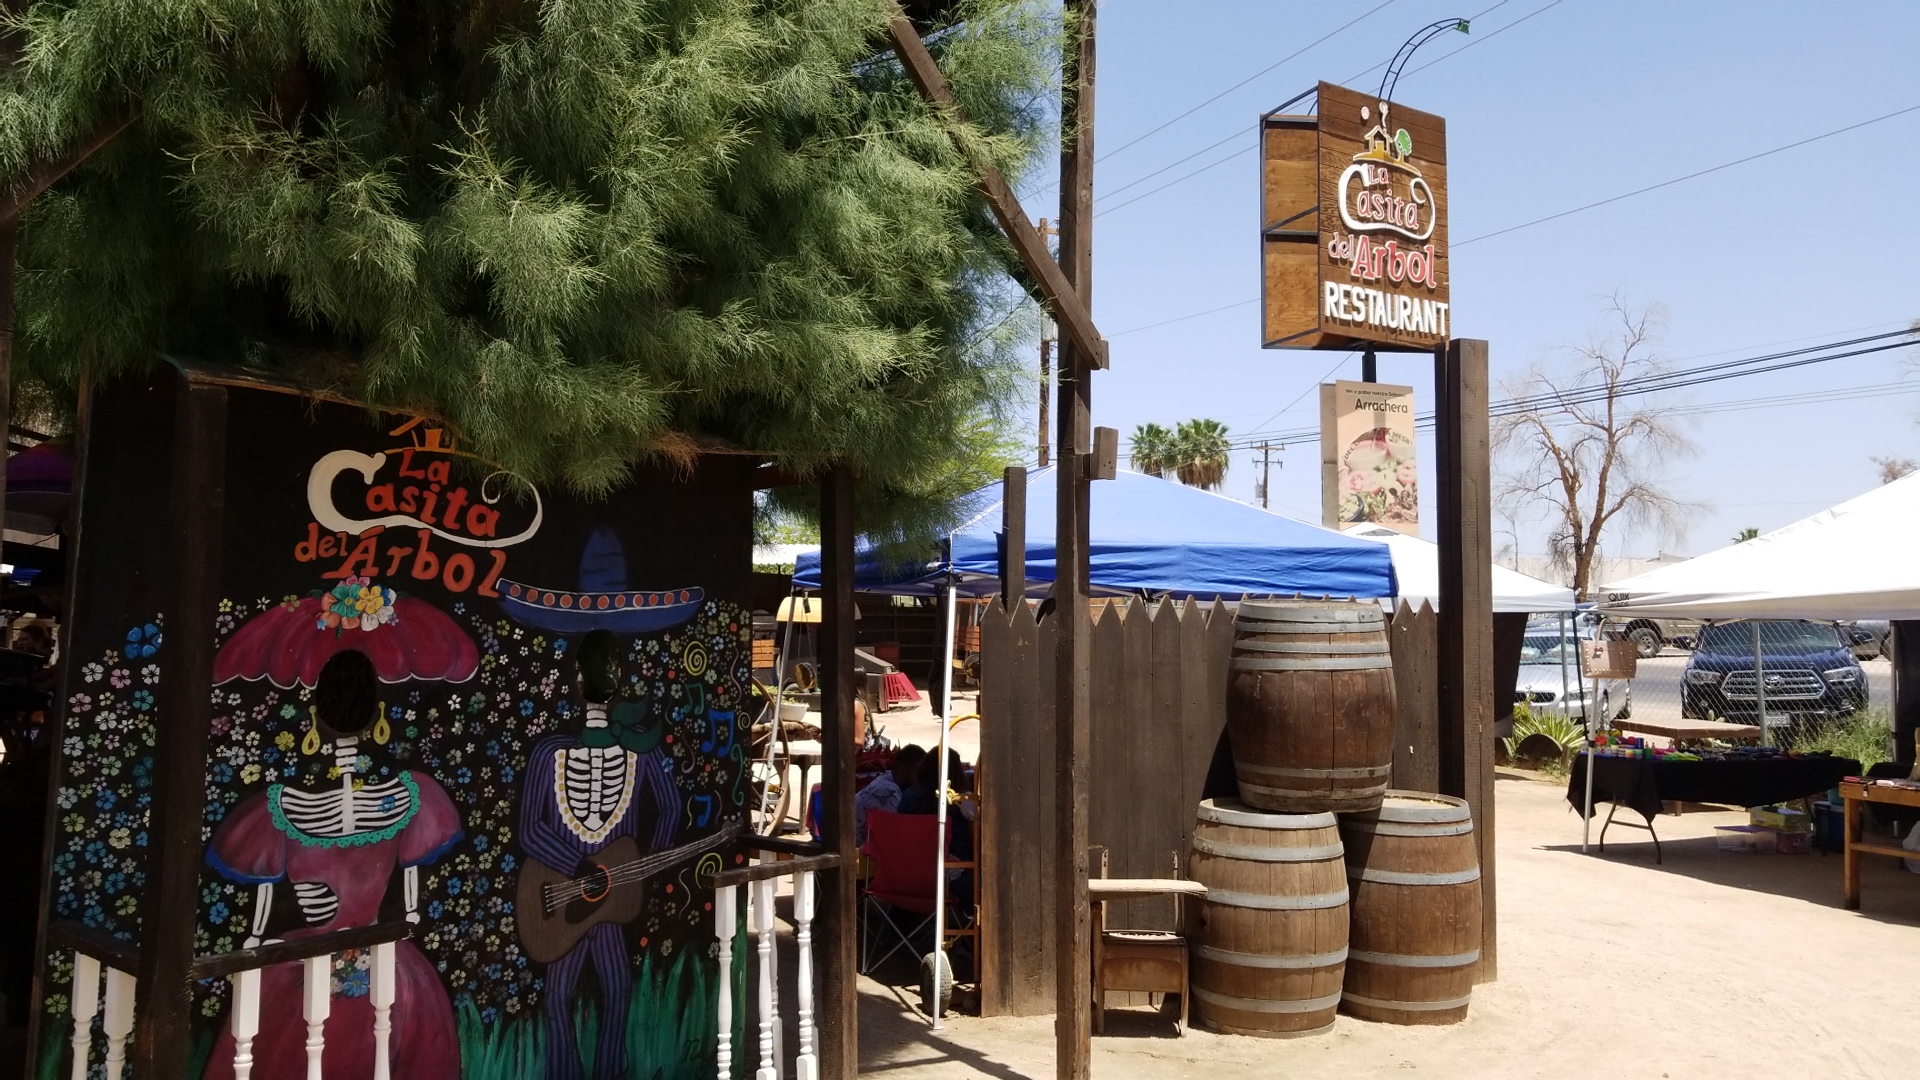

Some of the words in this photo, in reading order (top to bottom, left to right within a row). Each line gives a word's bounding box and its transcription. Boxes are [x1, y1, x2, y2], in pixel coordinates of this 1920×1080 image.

[1369, 165, 1389, 185] La
[1338, 164, 1435, 240] Casita
[1328, 232, 1354, 260] del
[1351, 235, 1437, 288] Arbol
[1324, 281, 1449, 336] RESTAURANT
[1354, 398, 1408, 414] Arrachera
[399, 449, 450, 485] La
[307, 449, 543, 547] Casita
[294, 522, 348, 562] del
[1608, 592, 1630, 602] QUIK
